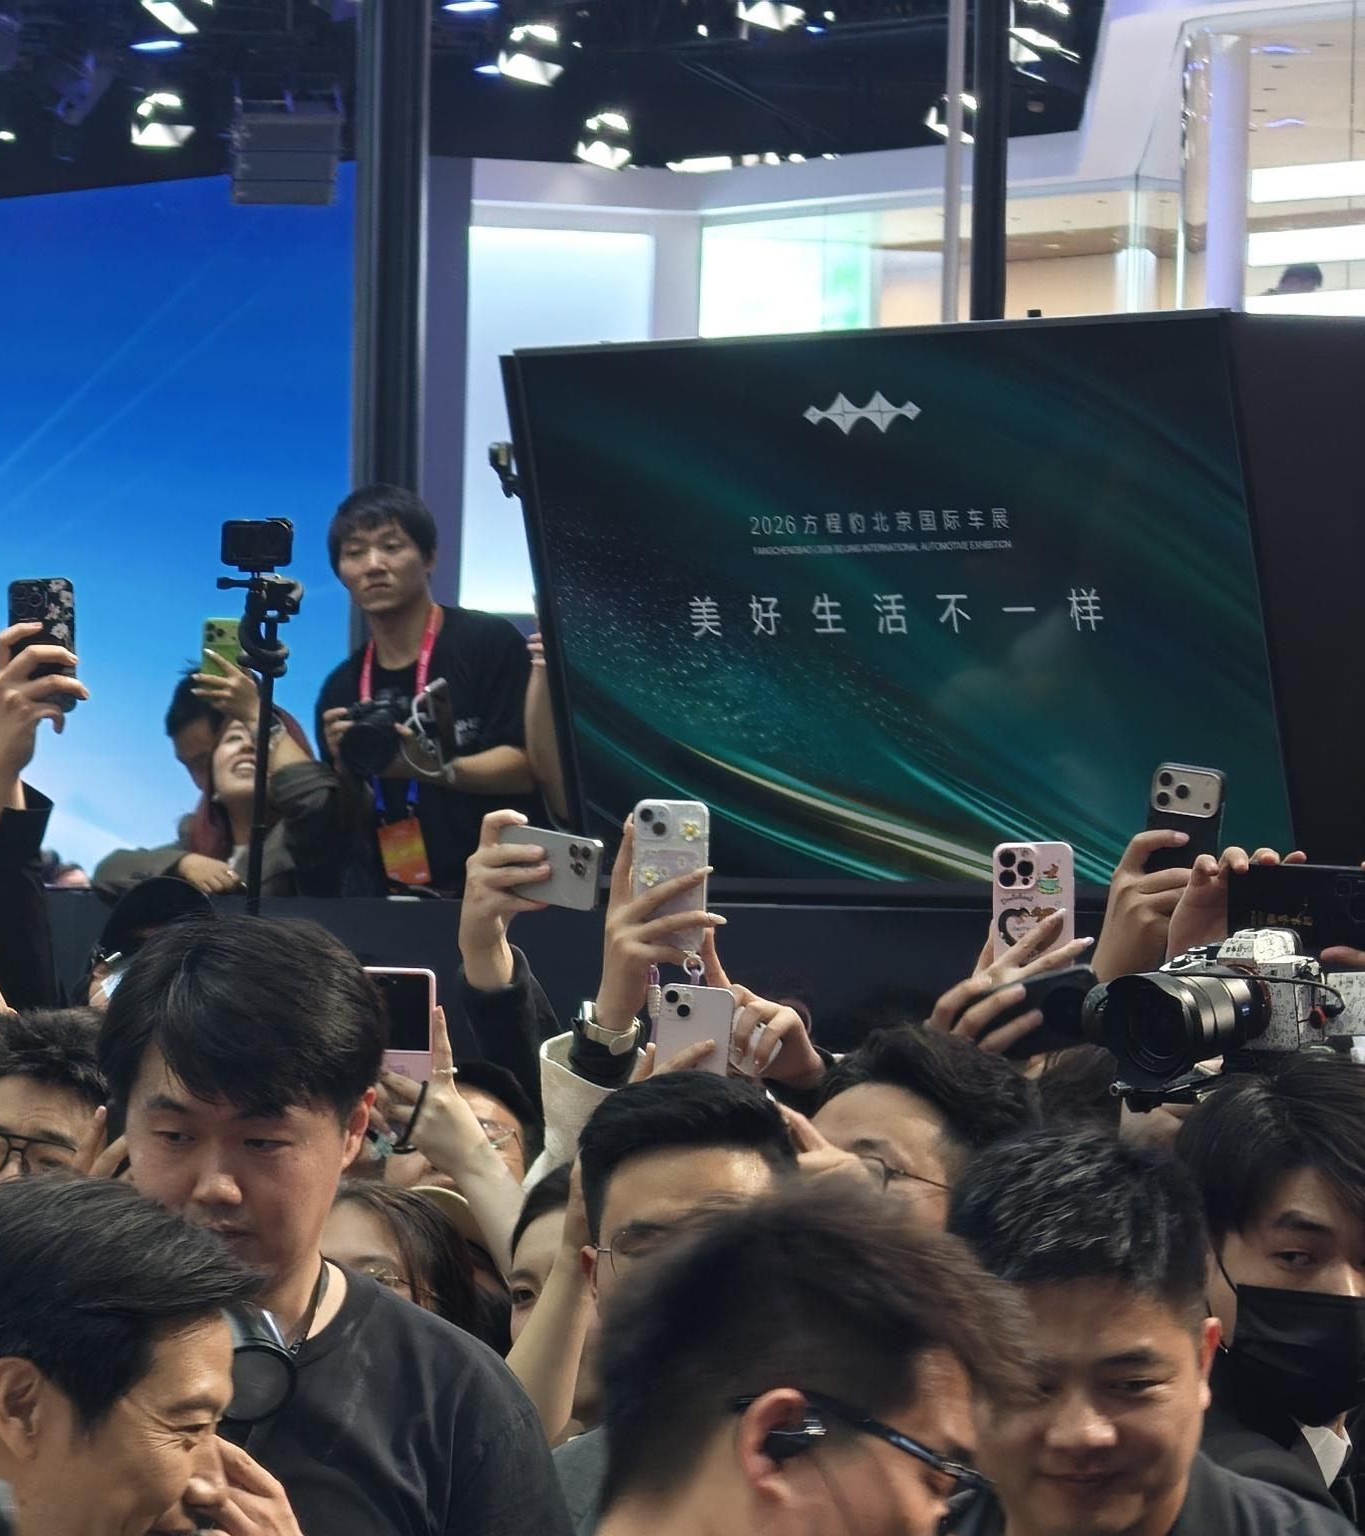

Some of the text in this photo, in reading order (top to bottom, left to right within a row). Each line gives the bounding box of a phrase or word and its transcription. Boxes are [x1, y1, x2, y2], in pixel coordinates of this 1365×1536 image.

[689, 588, 1103, 637] 美好生活不一样
